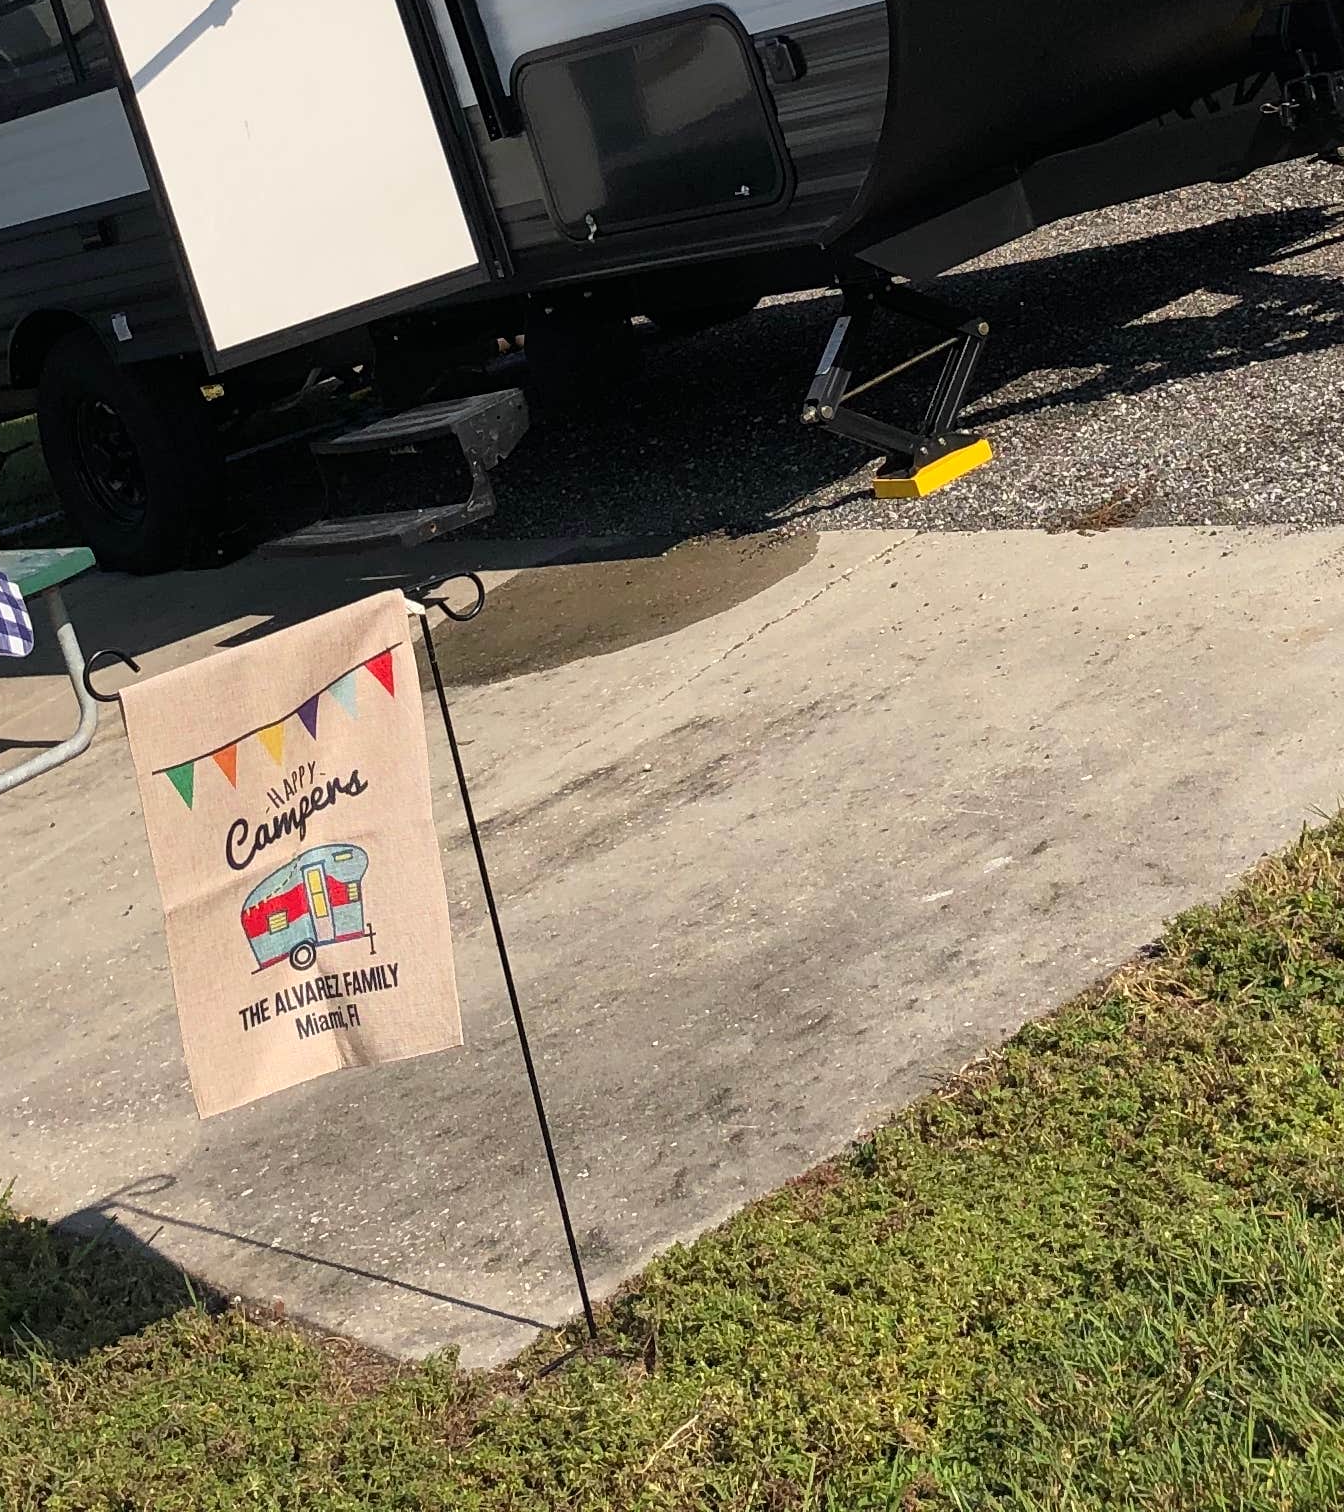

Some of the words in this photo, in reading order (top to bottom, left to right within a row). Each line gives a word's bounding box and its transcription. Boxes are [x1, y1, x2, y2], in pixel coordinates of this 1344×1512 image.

[266, 760, 317, 809] HAPPY
[225, 769, 369, 871] Campers
[238, 997, 272, 1032] THE
[274, 973, 344, 1017] ALVAREZ
[343, 962, 399, 997] FAMILY
[294, 1006, 349, 1040] Miami,
